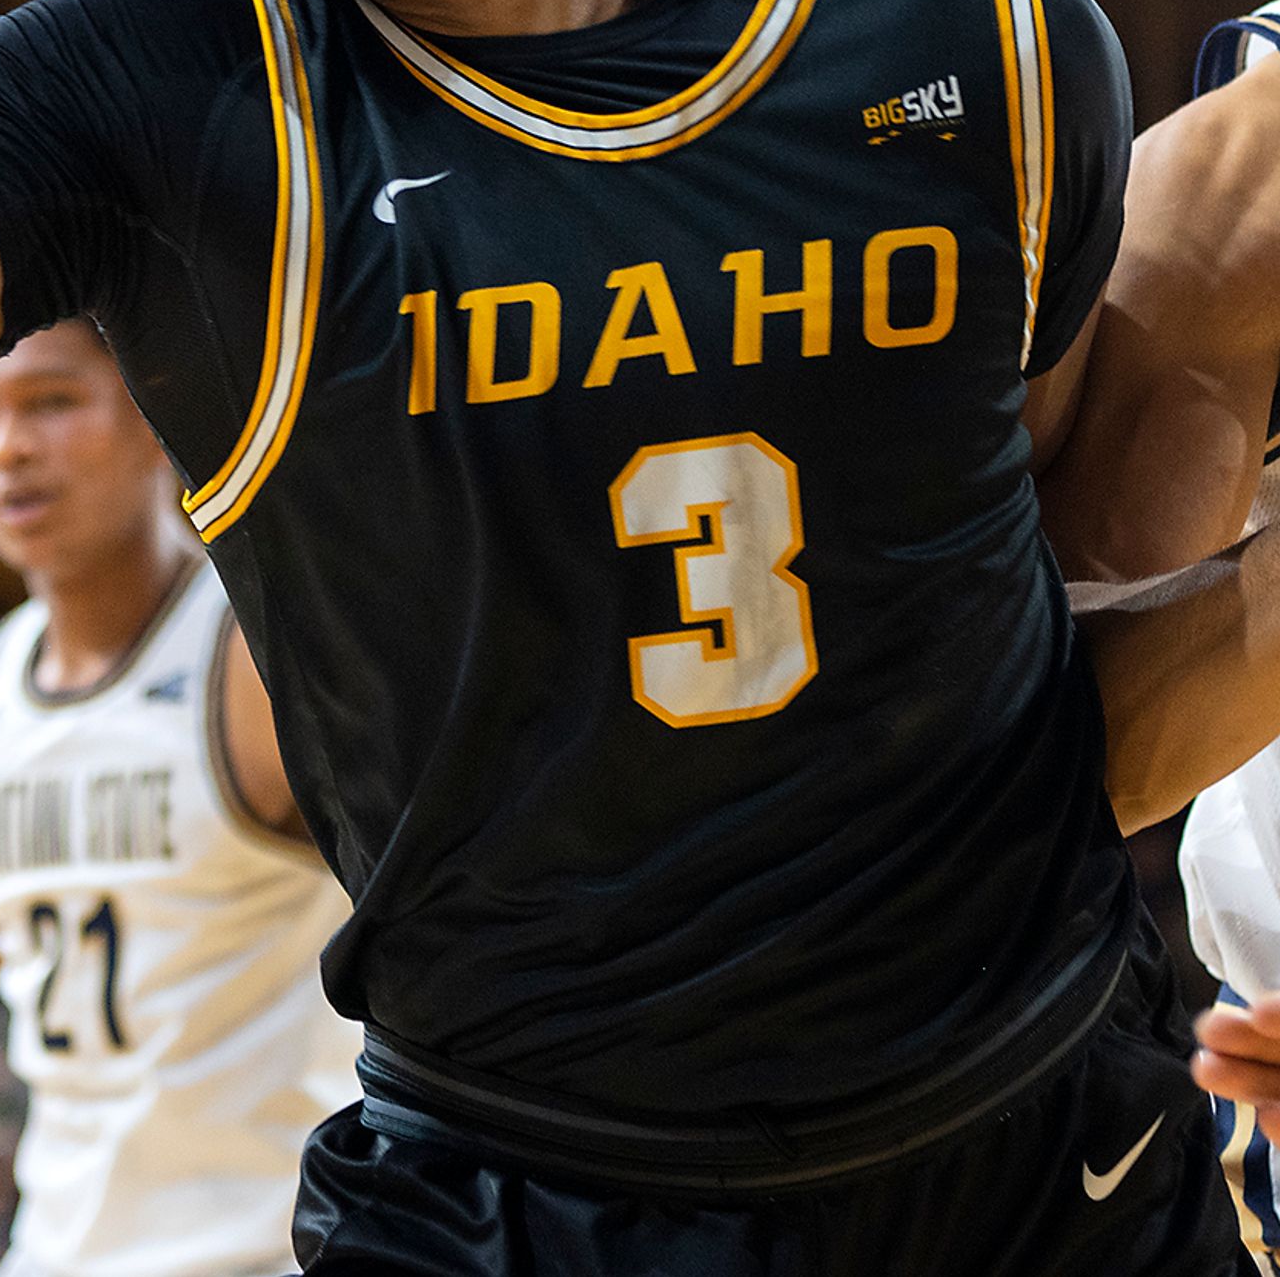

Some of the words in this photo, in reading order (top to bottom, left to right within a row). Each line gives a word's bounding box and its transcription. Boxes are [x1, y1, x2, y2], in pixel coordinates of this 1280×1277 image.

[397, 224, 960, 417] IDAHO
[607, 431, 820, 729] 3
[28, 891, 129, 1055] 21
